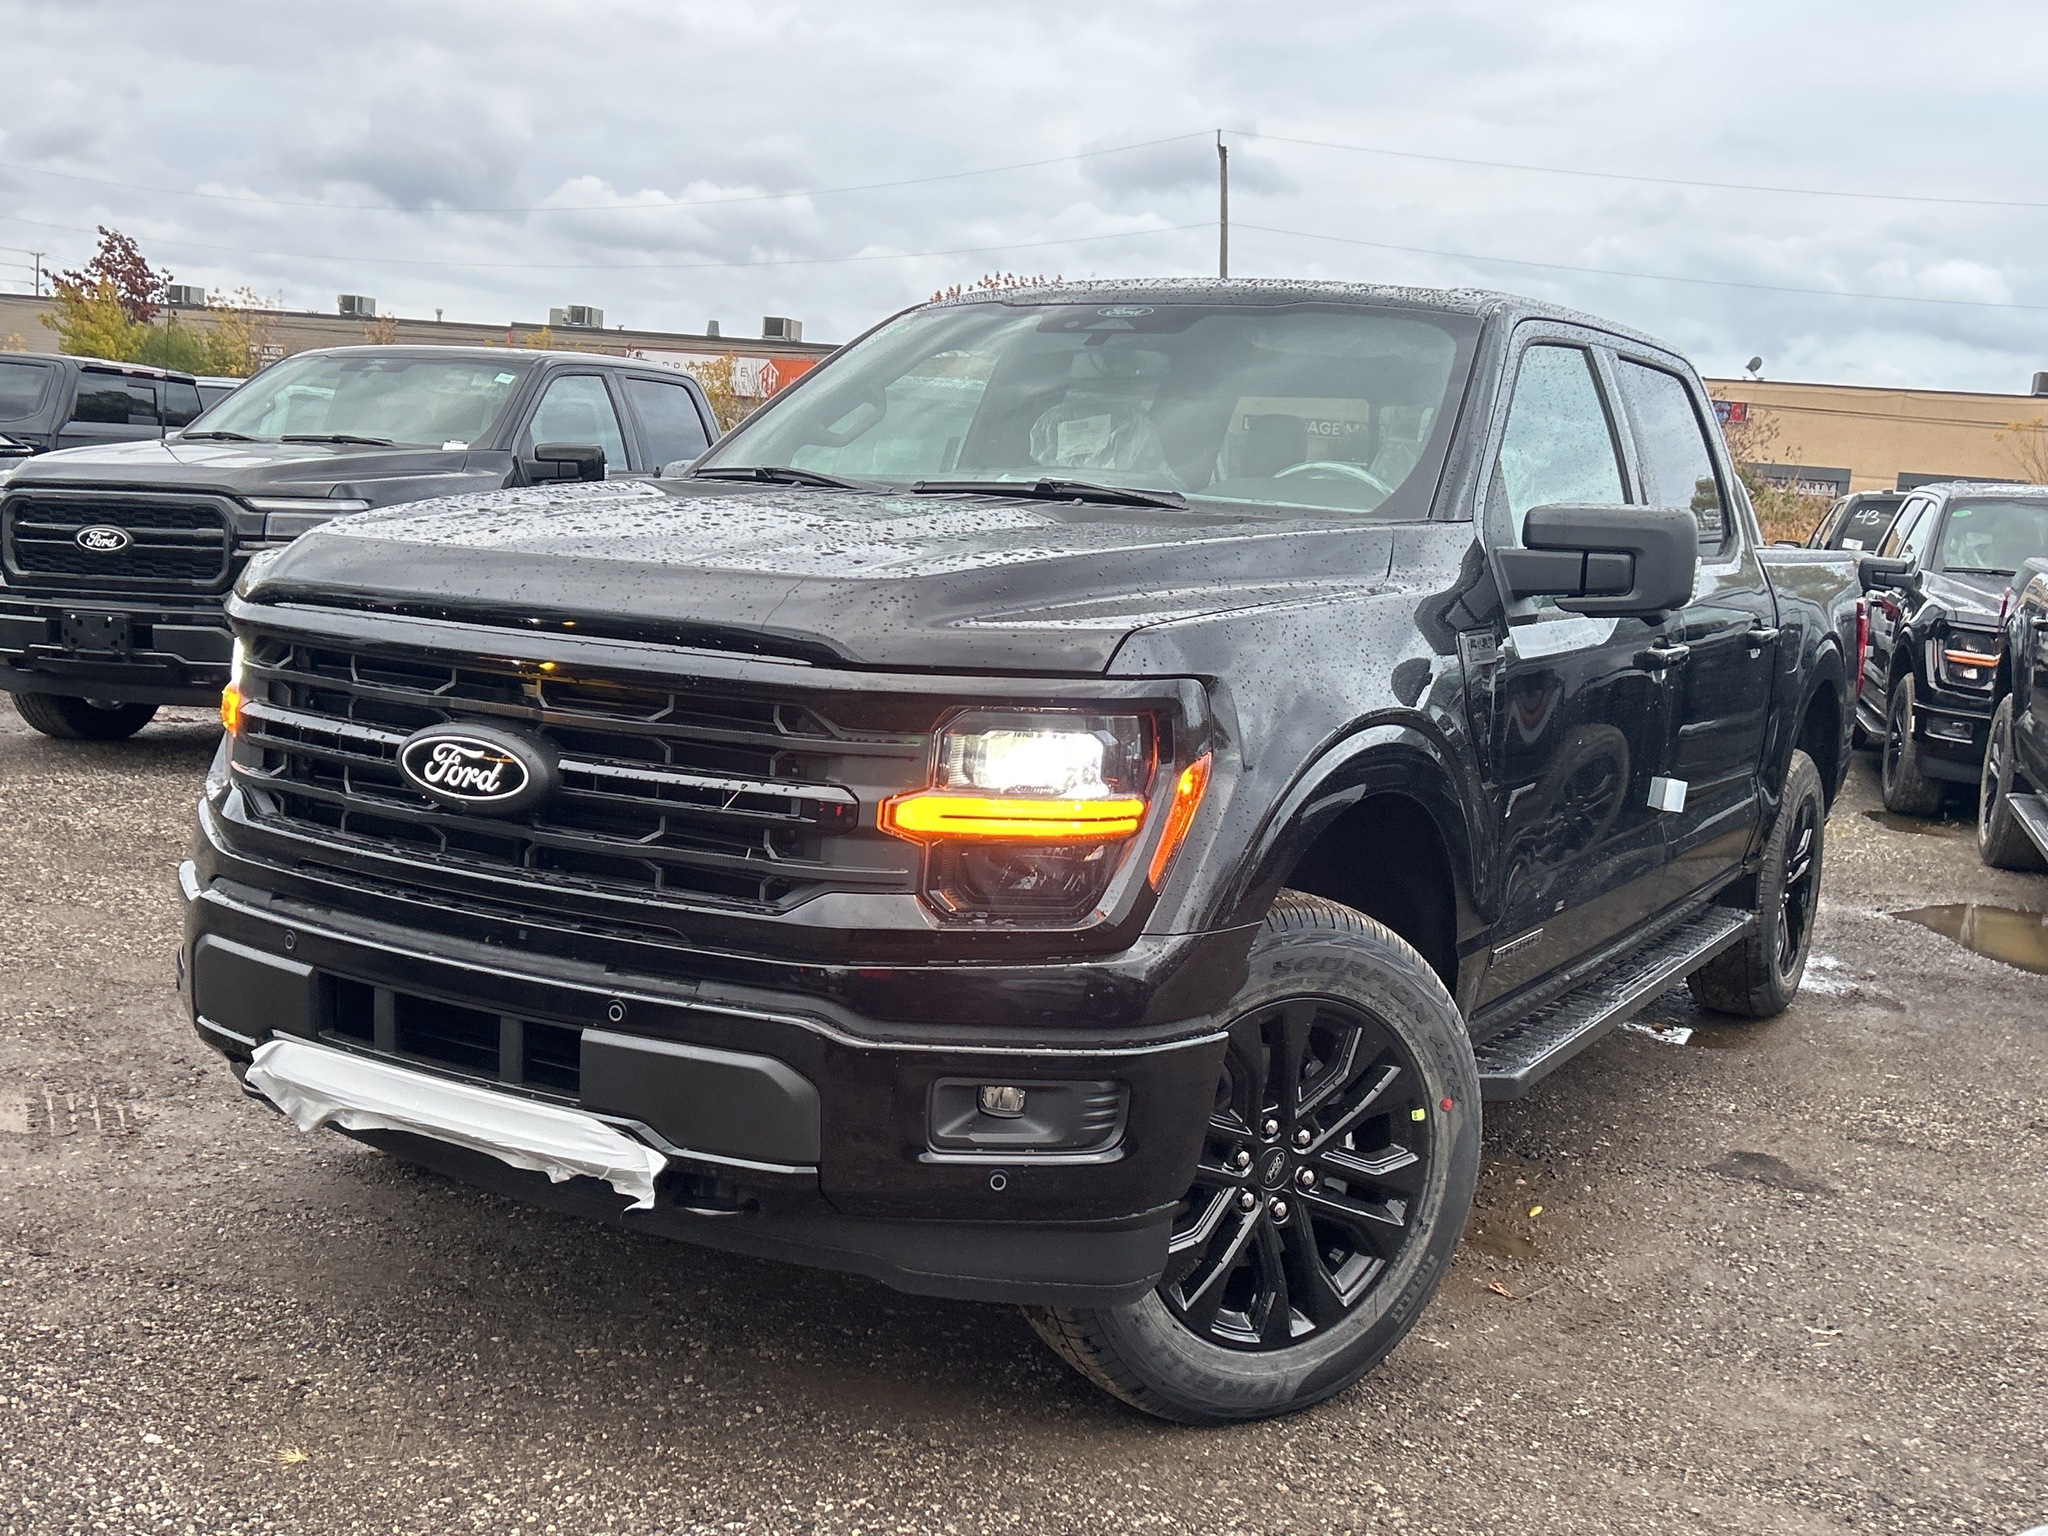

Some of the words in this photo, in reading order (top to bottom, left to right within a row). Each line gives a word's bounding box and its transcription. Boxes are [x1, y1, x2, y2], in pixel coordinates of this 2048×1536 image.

[1855, 509, 1880, 526] 43
[86, 531, 118, 547] Ford
[424, 743, 504, 793] Ford
